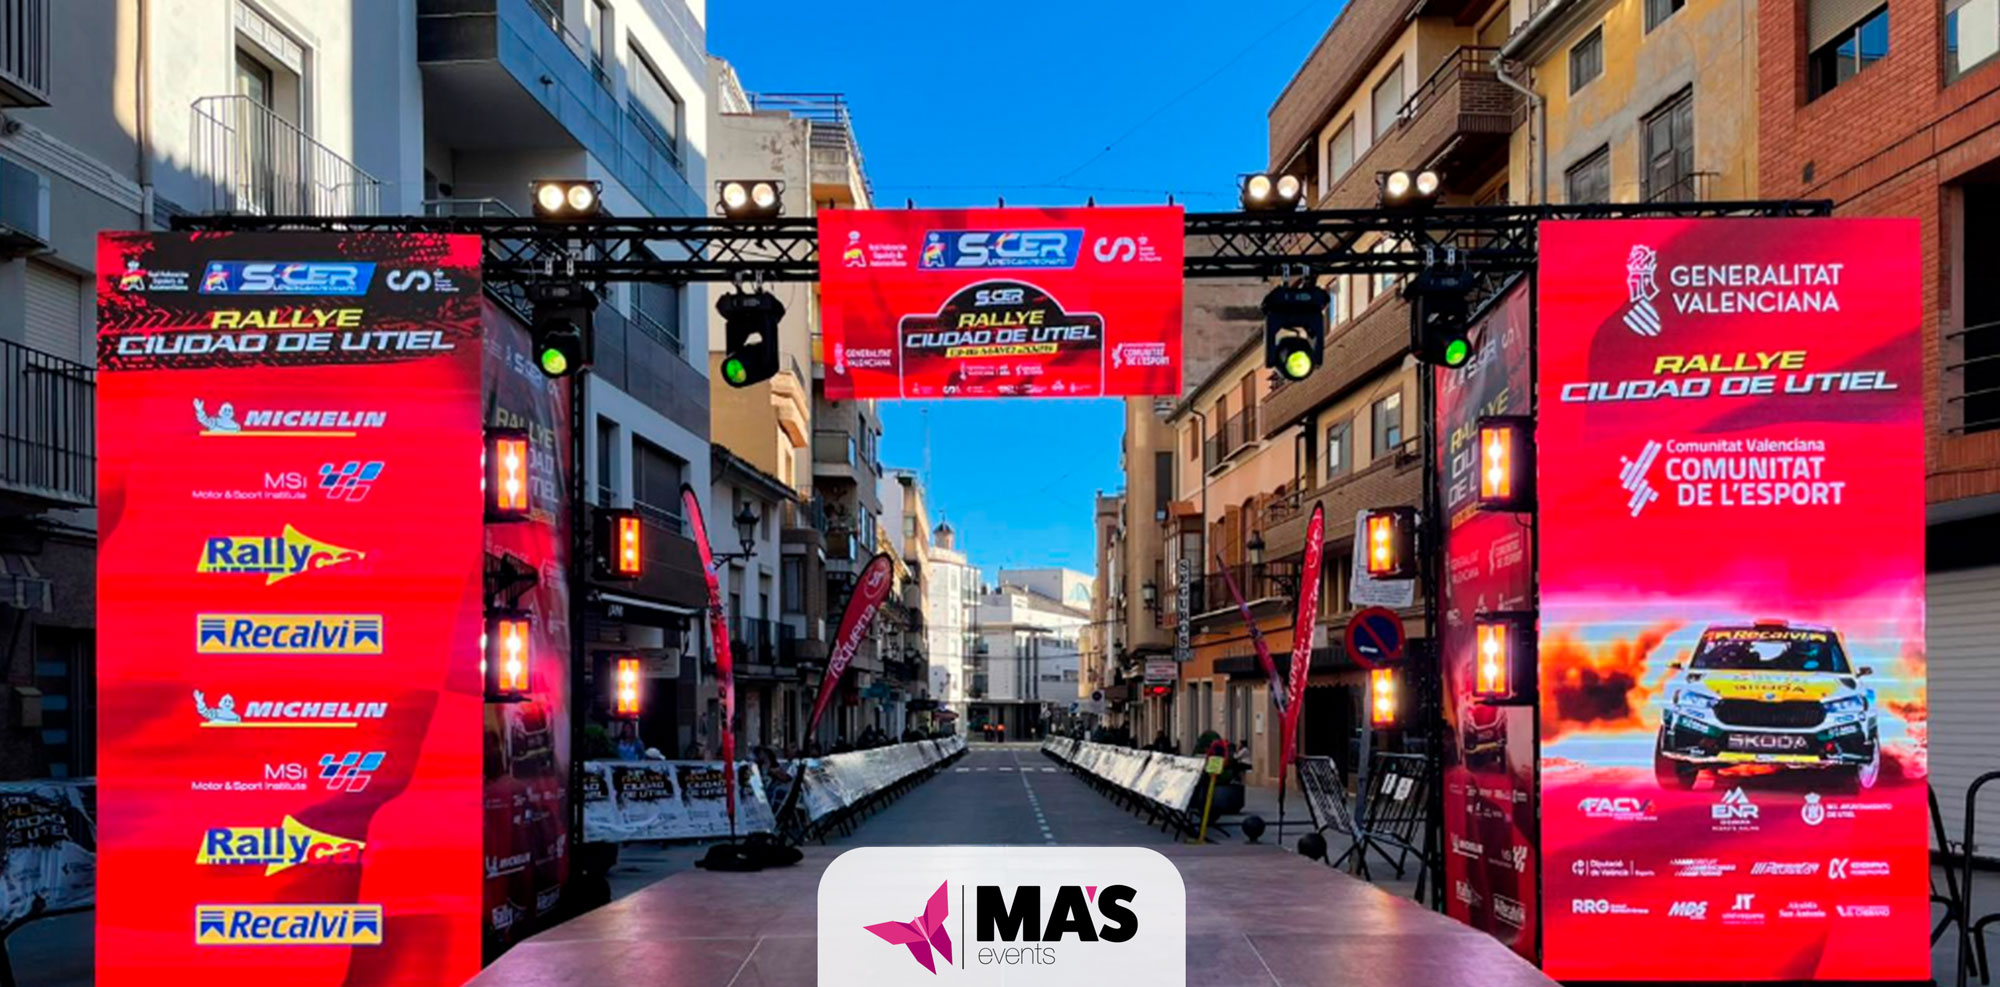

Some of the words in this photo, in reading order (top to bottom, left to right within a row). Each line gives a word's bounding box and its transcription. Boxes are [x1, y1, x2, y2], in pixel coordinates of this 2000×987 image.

[1670, 264, 1843, 287] GENERALITAT
[1672, 291, 1840, 314] VALENCIANA
[211, 308, 364, 330] RALLYE
[957, 310, 1045, 328] RALLYE
[117, 335, 265, 355] CIUDAD
[276, 333, 331, 352] DE
[341, 331, 455, 351] UTIEL
[906, 331, 991, 347] CIUDAD
[996, 328, 1028, 343] DE
[1032, 325, 1097, 341] UTIEL
[1653, 351, 1807, 375] RALLYE
[1560, 377, 1711, 402] CIUDAD
[1719, 375, 1777, 396] DE
[1784, 371, 1898, 394] UTIEL
[245, 410, 386, 428] MICHELIN
[1666, 439, 1742, 453] Comunitat
[1746, 438, 1825, 452] Valenciana
[1666, 457, 1825, 481] COMUNITAT
[1677, 484, 1713, 506] DE
[1720, 482, 1846, 506] L'ESPORT
[1179, 561, 1189, 648] SEGUROS
[230, 619, 350, 649] Recalvi
[245, 702, 388, 718] MICHELIN
[233, 781, 262, 792] Sport
[1712, 804, 1759, 818] ENR
[1572, 899, 1609, 914] RRG
[229, 910, 350, 940] Recalvi
